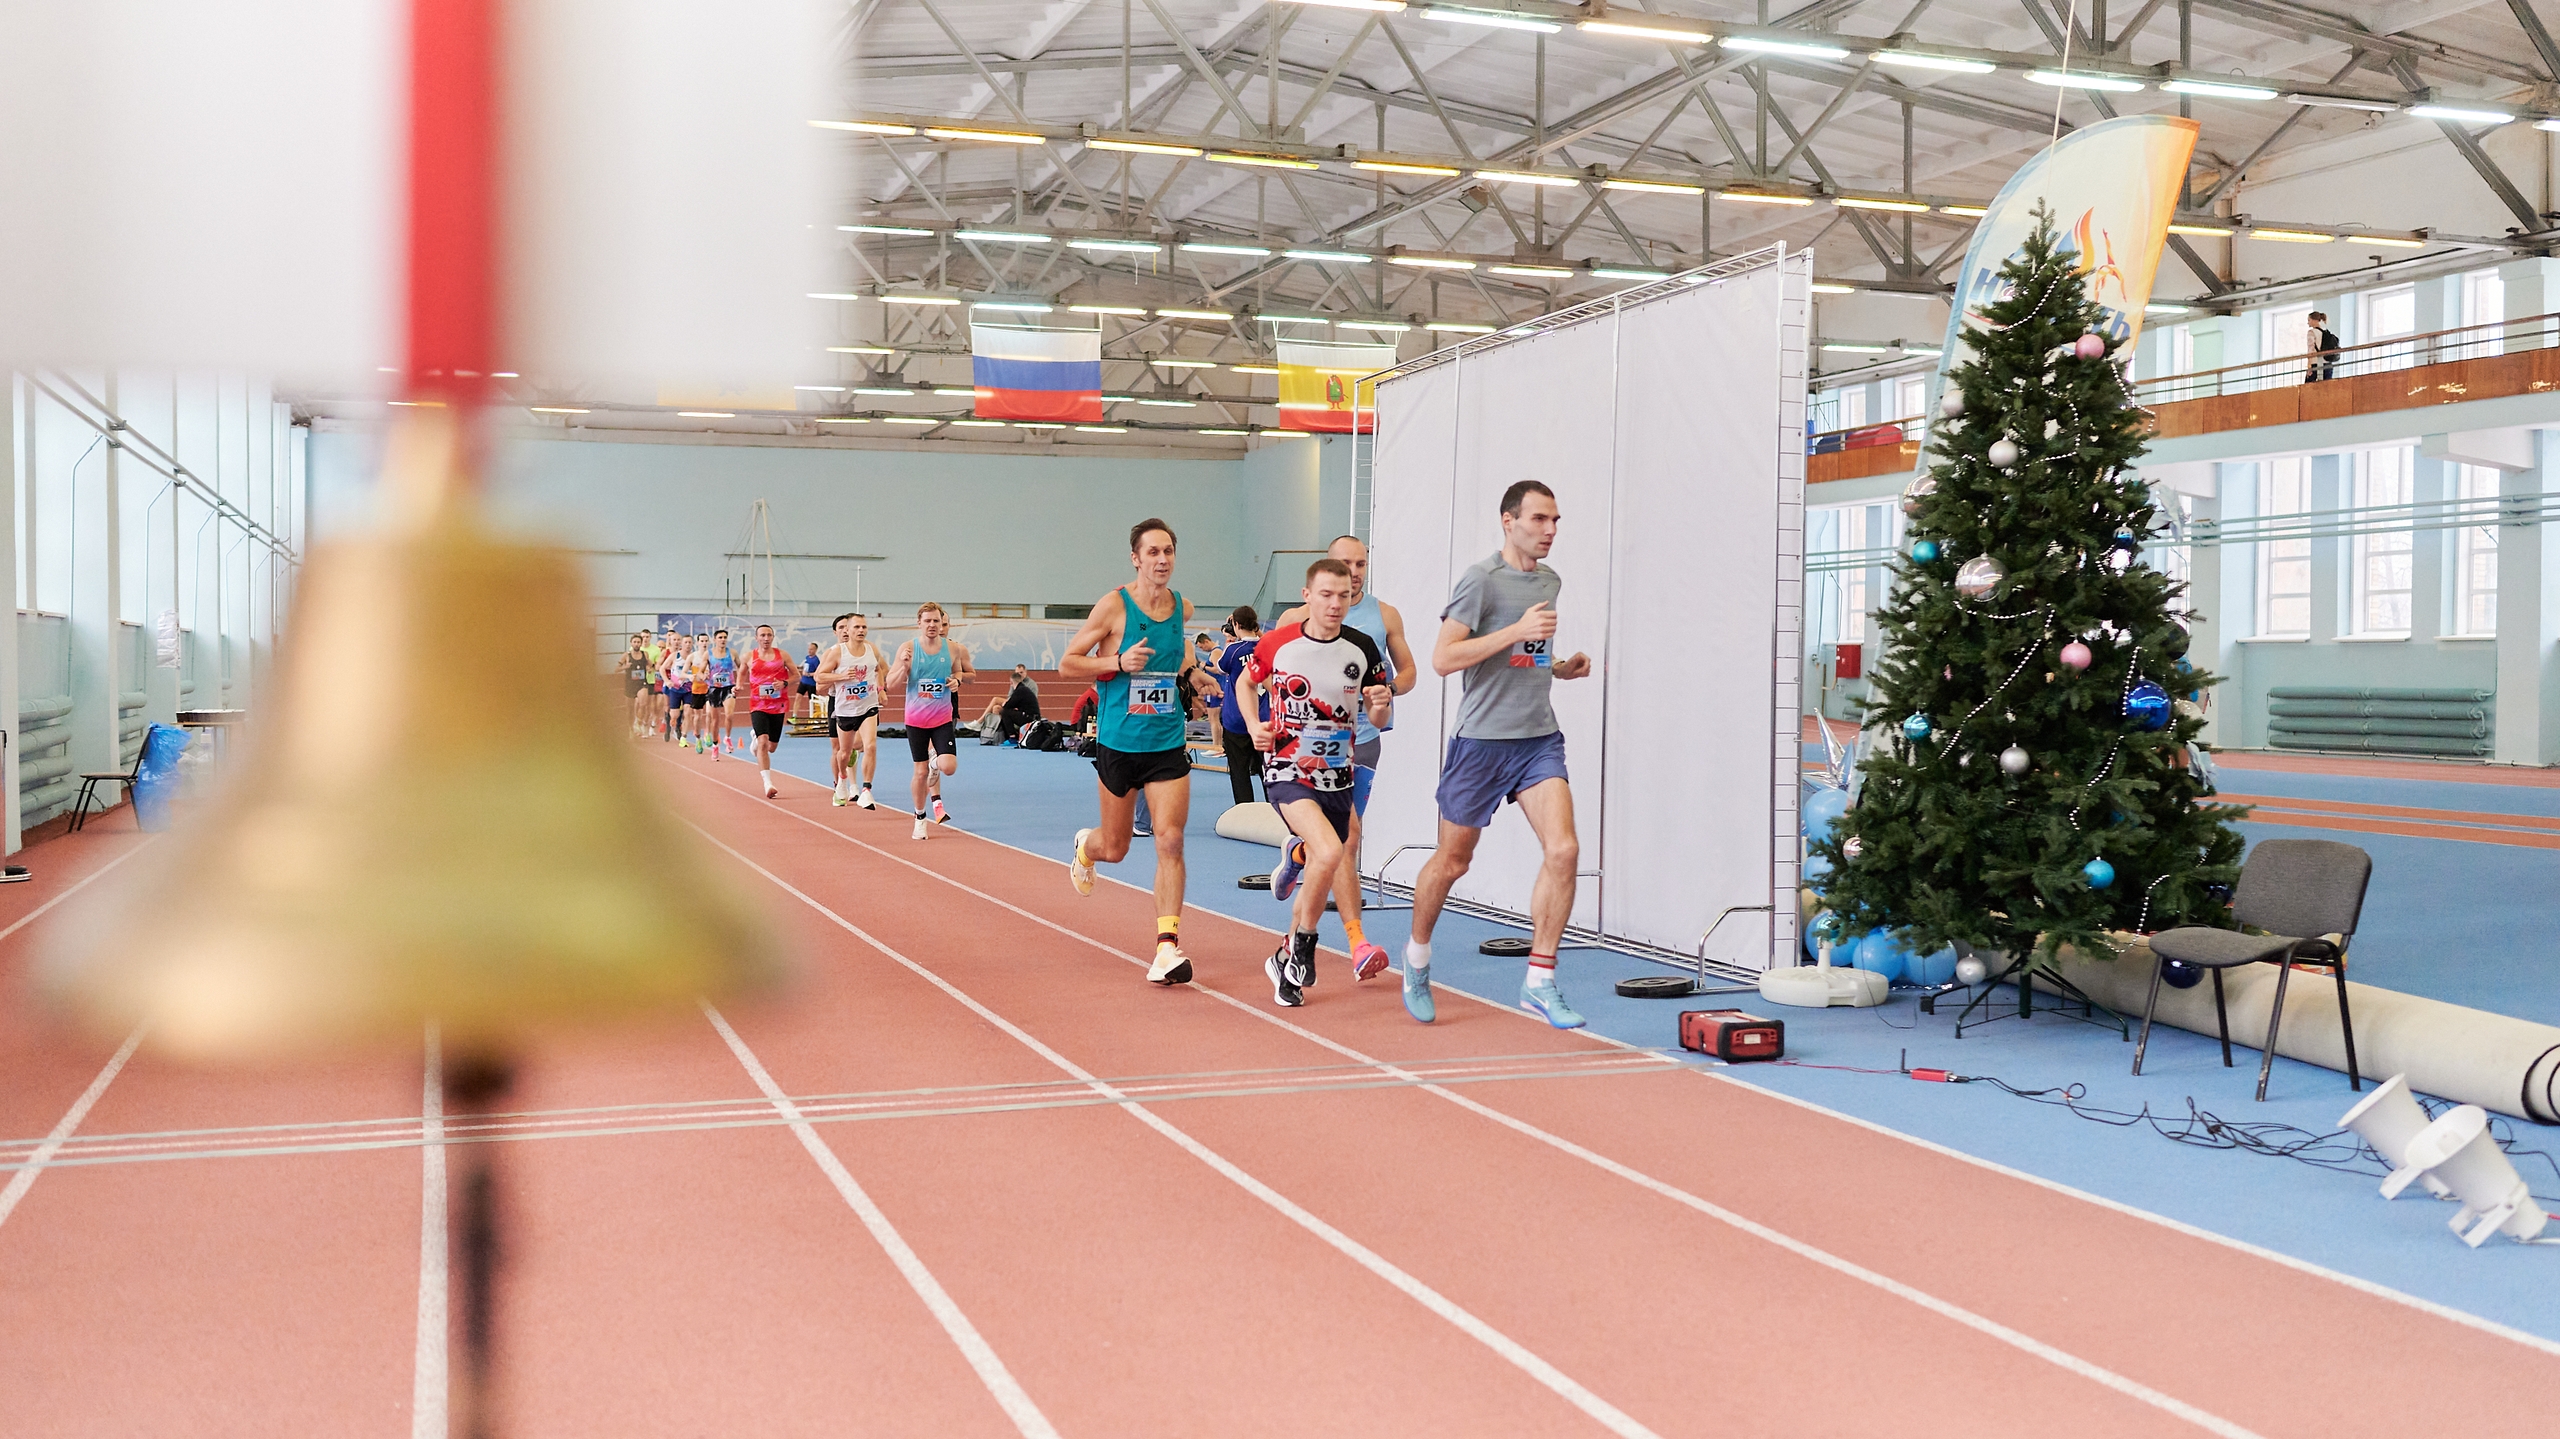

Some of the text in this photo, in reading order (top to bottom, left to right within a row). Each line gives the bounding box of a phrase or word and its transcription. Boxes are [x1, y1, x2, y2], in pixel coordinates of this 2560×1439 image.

[1523, 639, 1546, 654] 62
[847, 686, 867, 695] 102
[920, 683, 943, 692] 122
[1137, 689, 1168, 703] 141
[1311, 740, 1341, 756] 32
